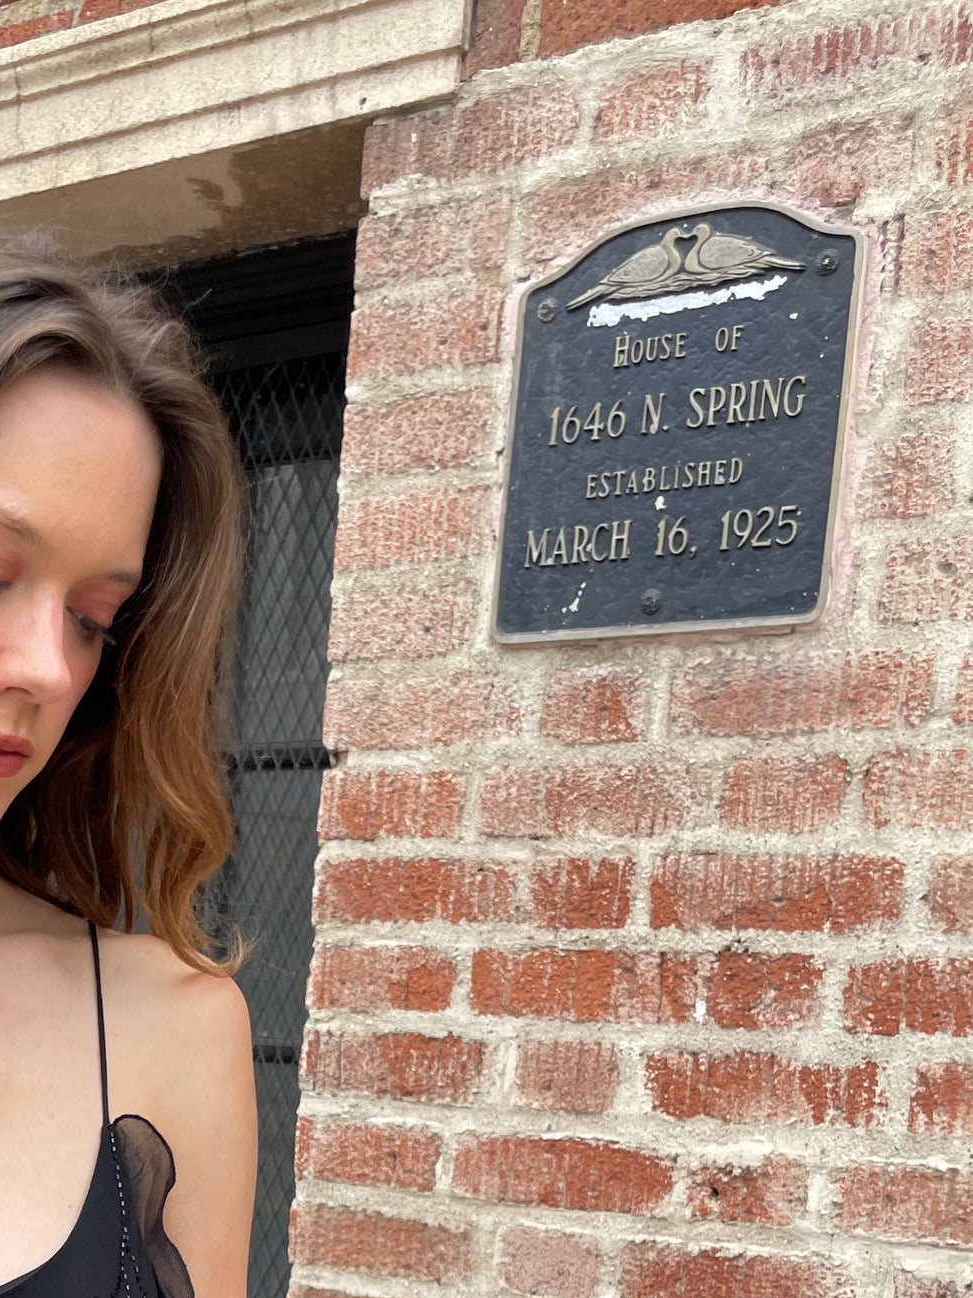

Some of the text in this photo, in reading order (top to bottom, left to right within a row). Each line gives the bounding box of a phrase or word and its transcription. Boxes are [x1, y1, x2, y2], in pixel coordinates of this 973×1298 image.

[613, 324, 745, 368] HOUSE OF
[548, 375, 807, 446] 1646 N. SPRING
[585, 457, 743, 499] ESTABLISHED
[524, 505, 799, 567] MARCH 16, 1925
